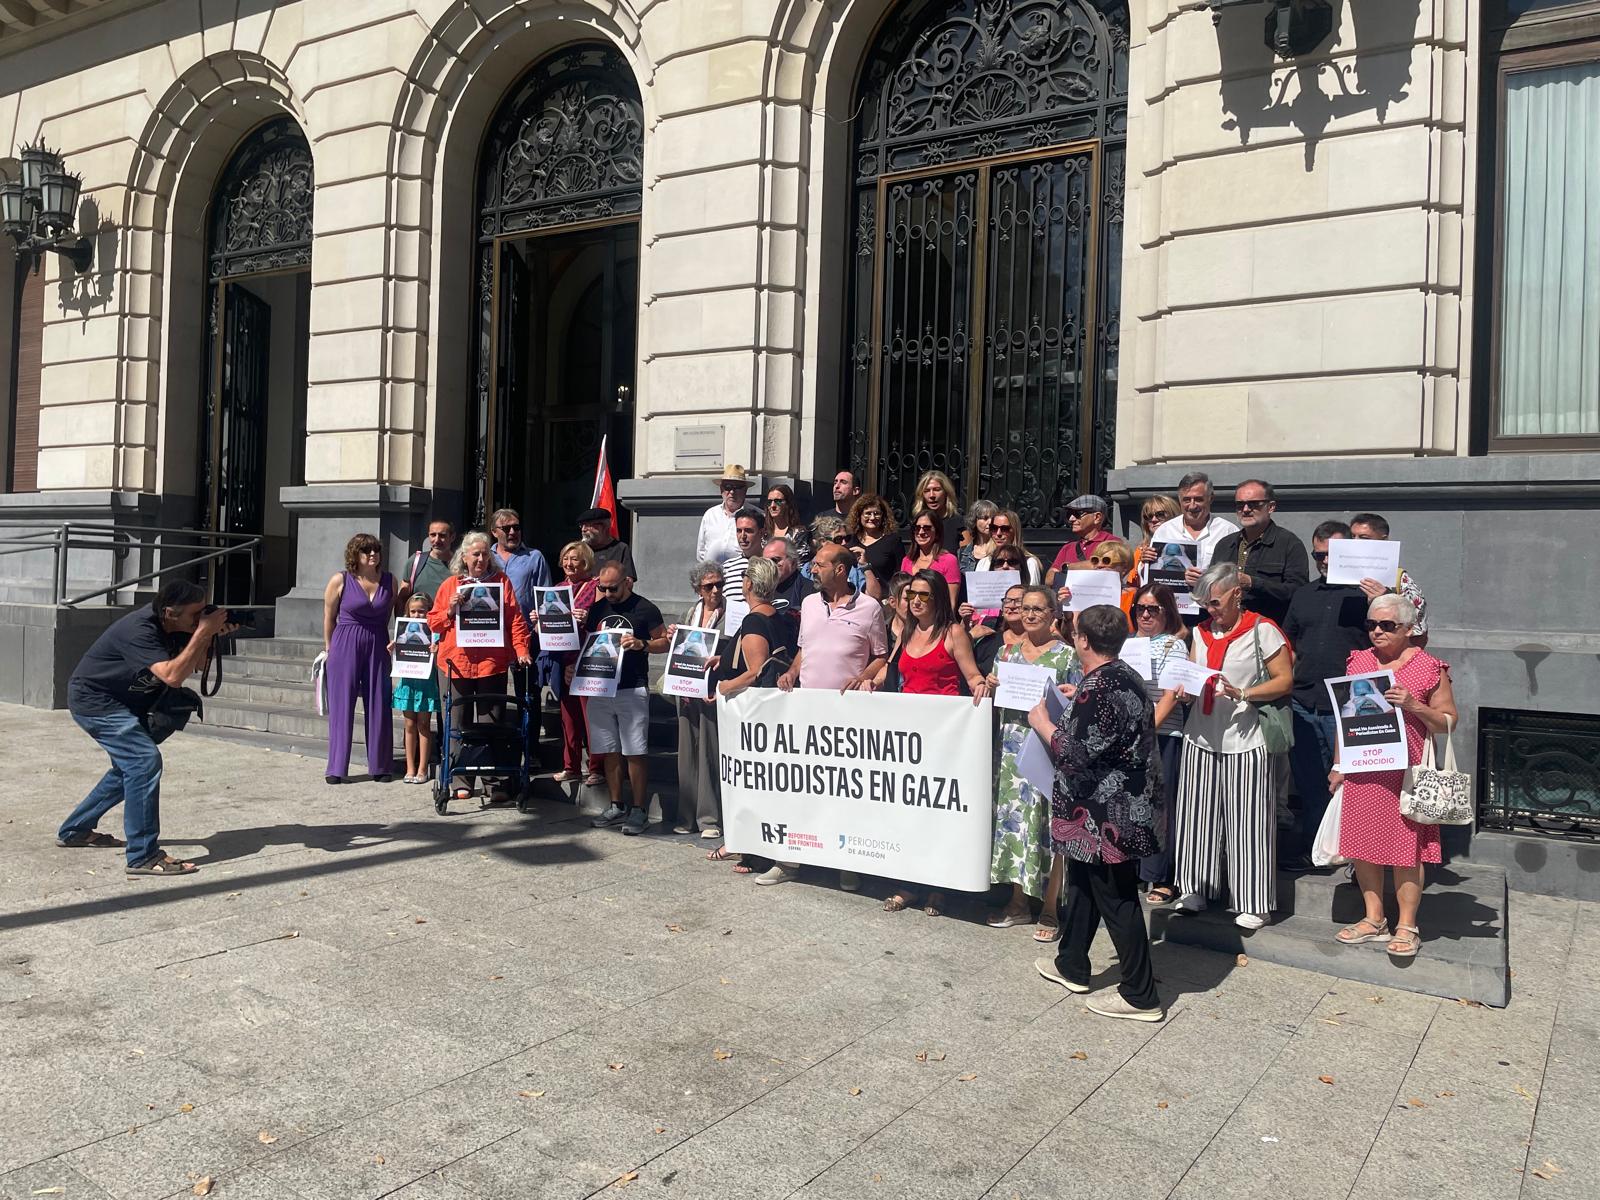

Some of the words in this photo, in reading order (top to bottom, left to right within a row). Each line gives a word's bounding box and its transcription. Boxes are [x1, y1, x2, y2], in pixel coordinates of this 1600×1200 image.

[741, 722, 768, 753] NO
[774, 723, 800, 755] AL
[805, 725, 922, 765] ASESINATO
[1362, 749, 1383, 757] STOP
[1352, 758, 1395, 767] GENOCIDIO
[721, 753, 731, 785] DE
[733, 759, 863, 799] PERIODISTAS
[870, 770, 896, 803] EN
[902, 773, 968, 813] GAZA.
[761, 822, 787, 844] RSF
[787, 832, 818, 841] REPORTEROS
[797, 840, 824, 849] FRONTERAS
[848, 835, 901, 853] PERIODISTAS
[857, 849, 886, 860] ARAGÓN
